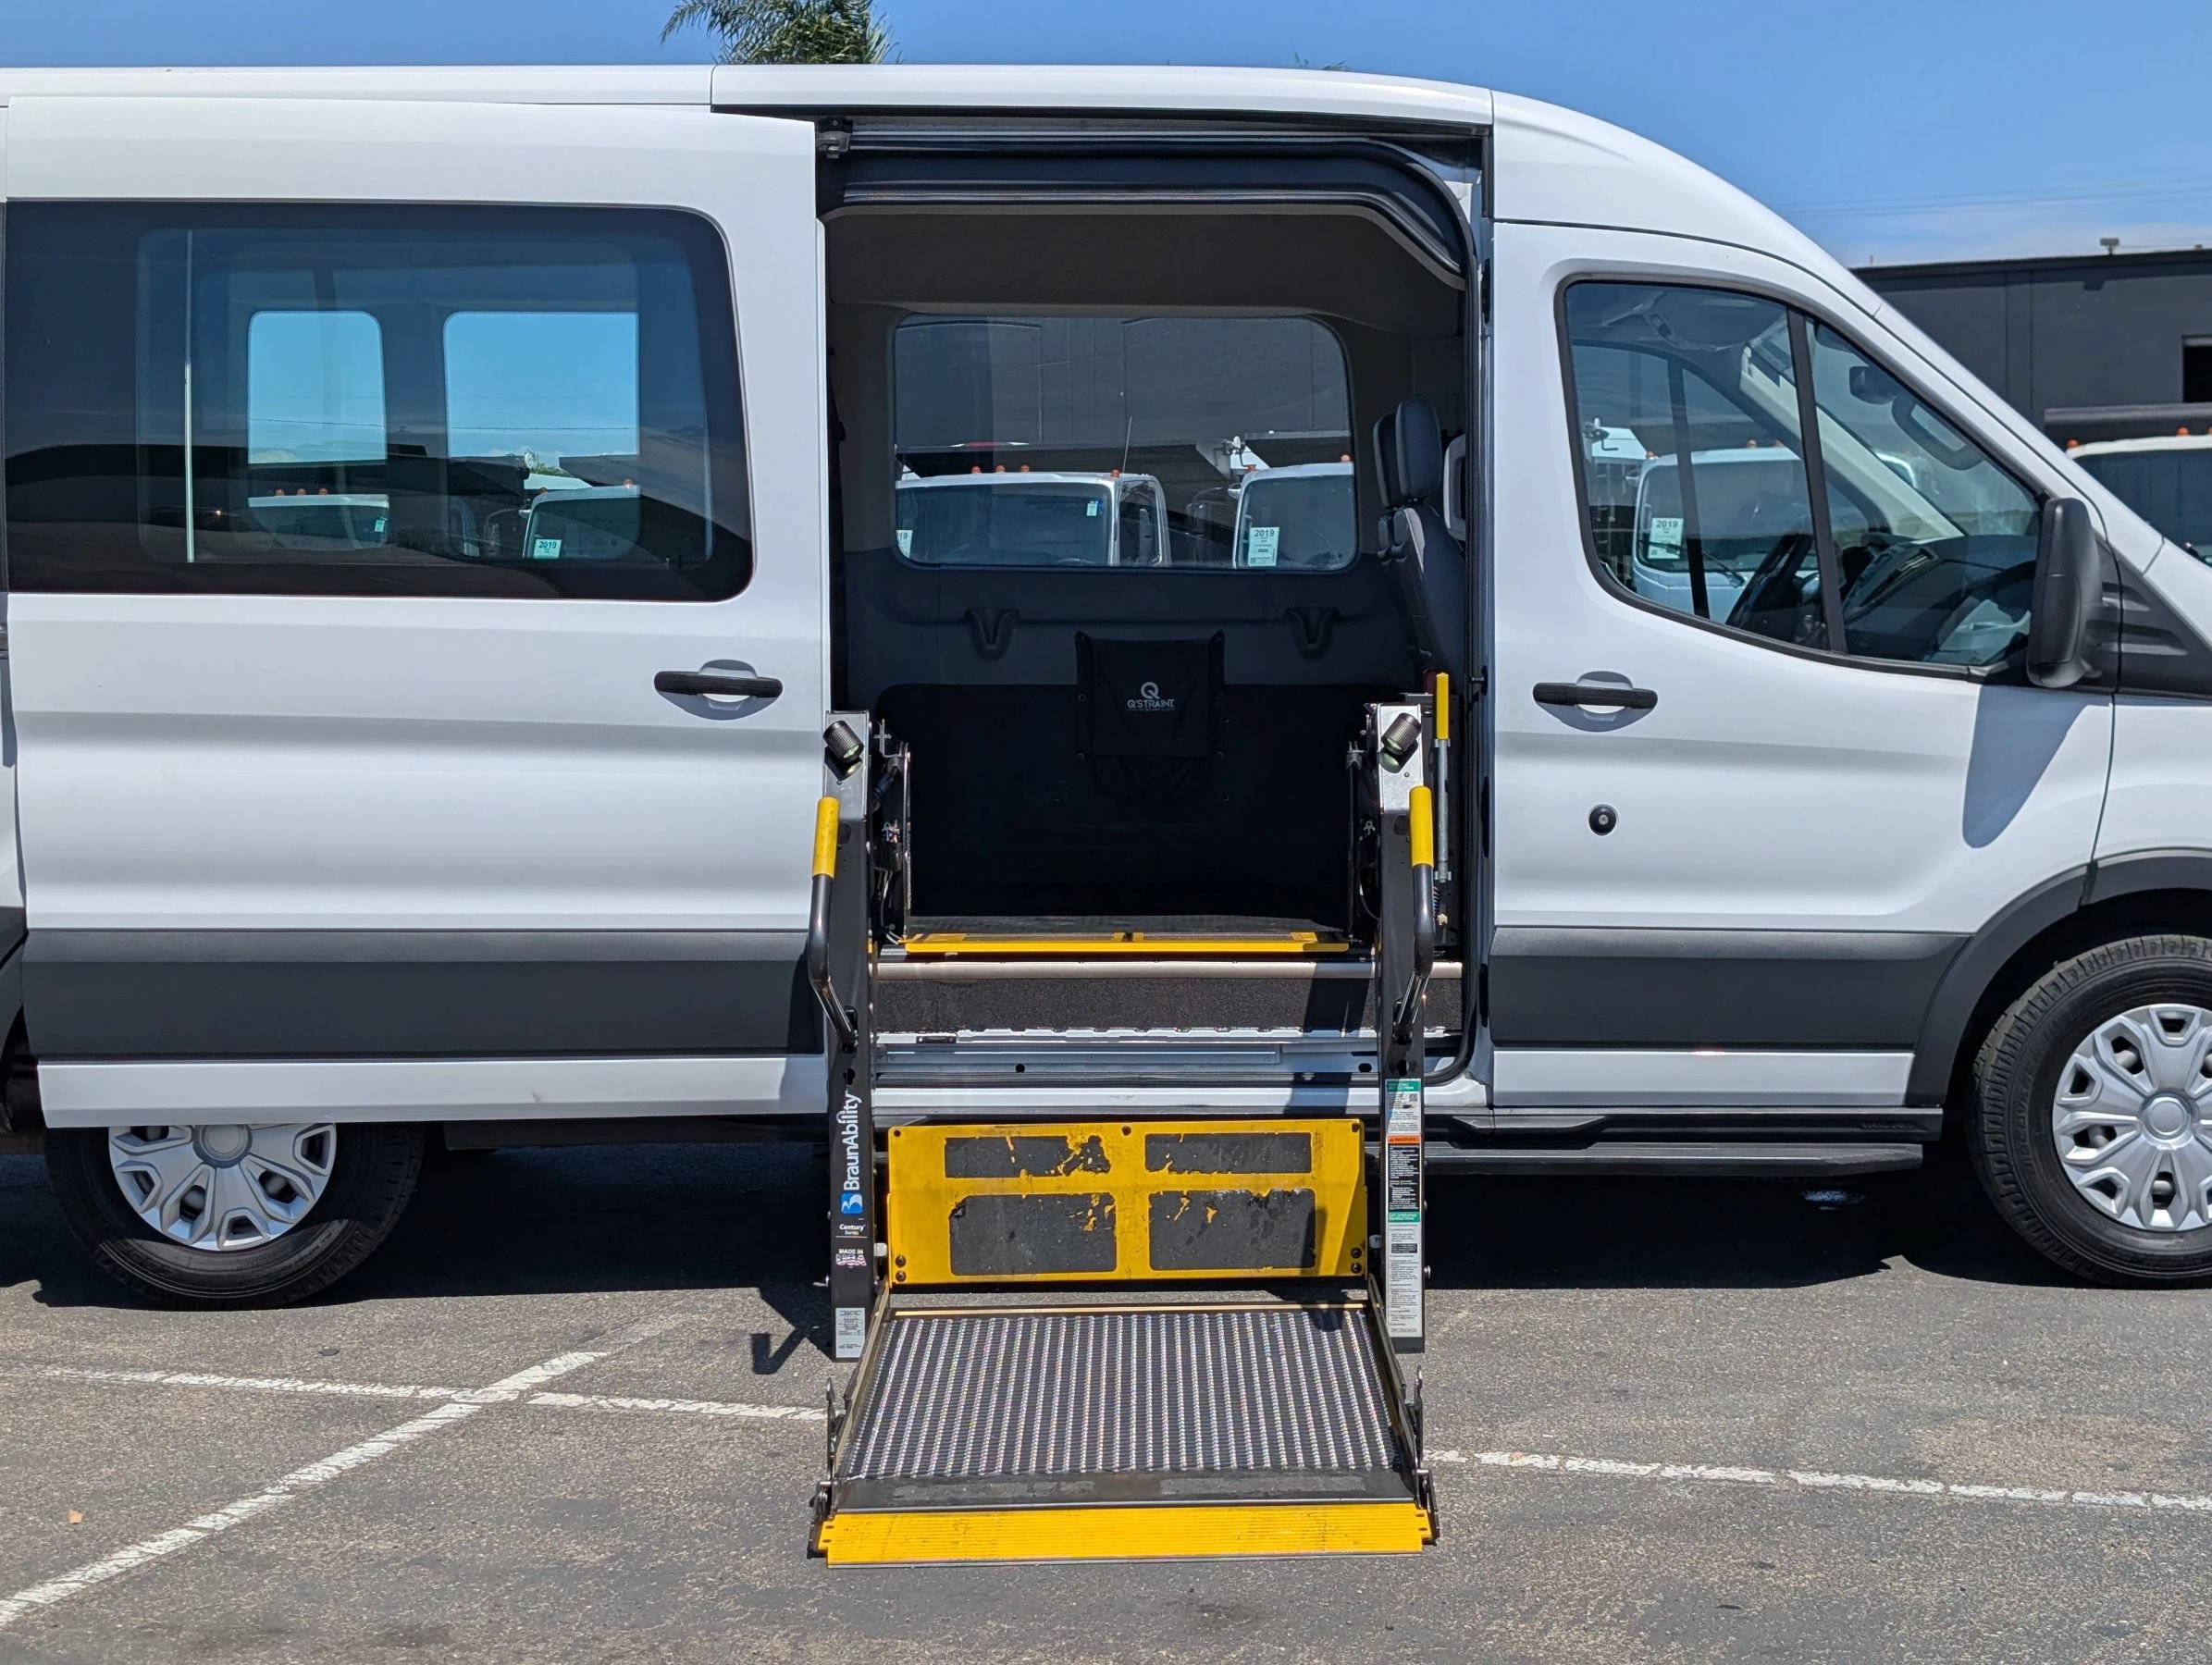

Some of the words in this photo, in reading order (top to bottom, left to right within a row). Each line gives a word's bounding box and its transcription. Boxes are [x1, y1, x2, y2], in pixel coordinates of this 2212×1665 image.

[1655, 520, 1679, 529] 2019
[1254, 529, 1275, 537] 2019
[837, 1091, 862, 1190] BraunAbility
